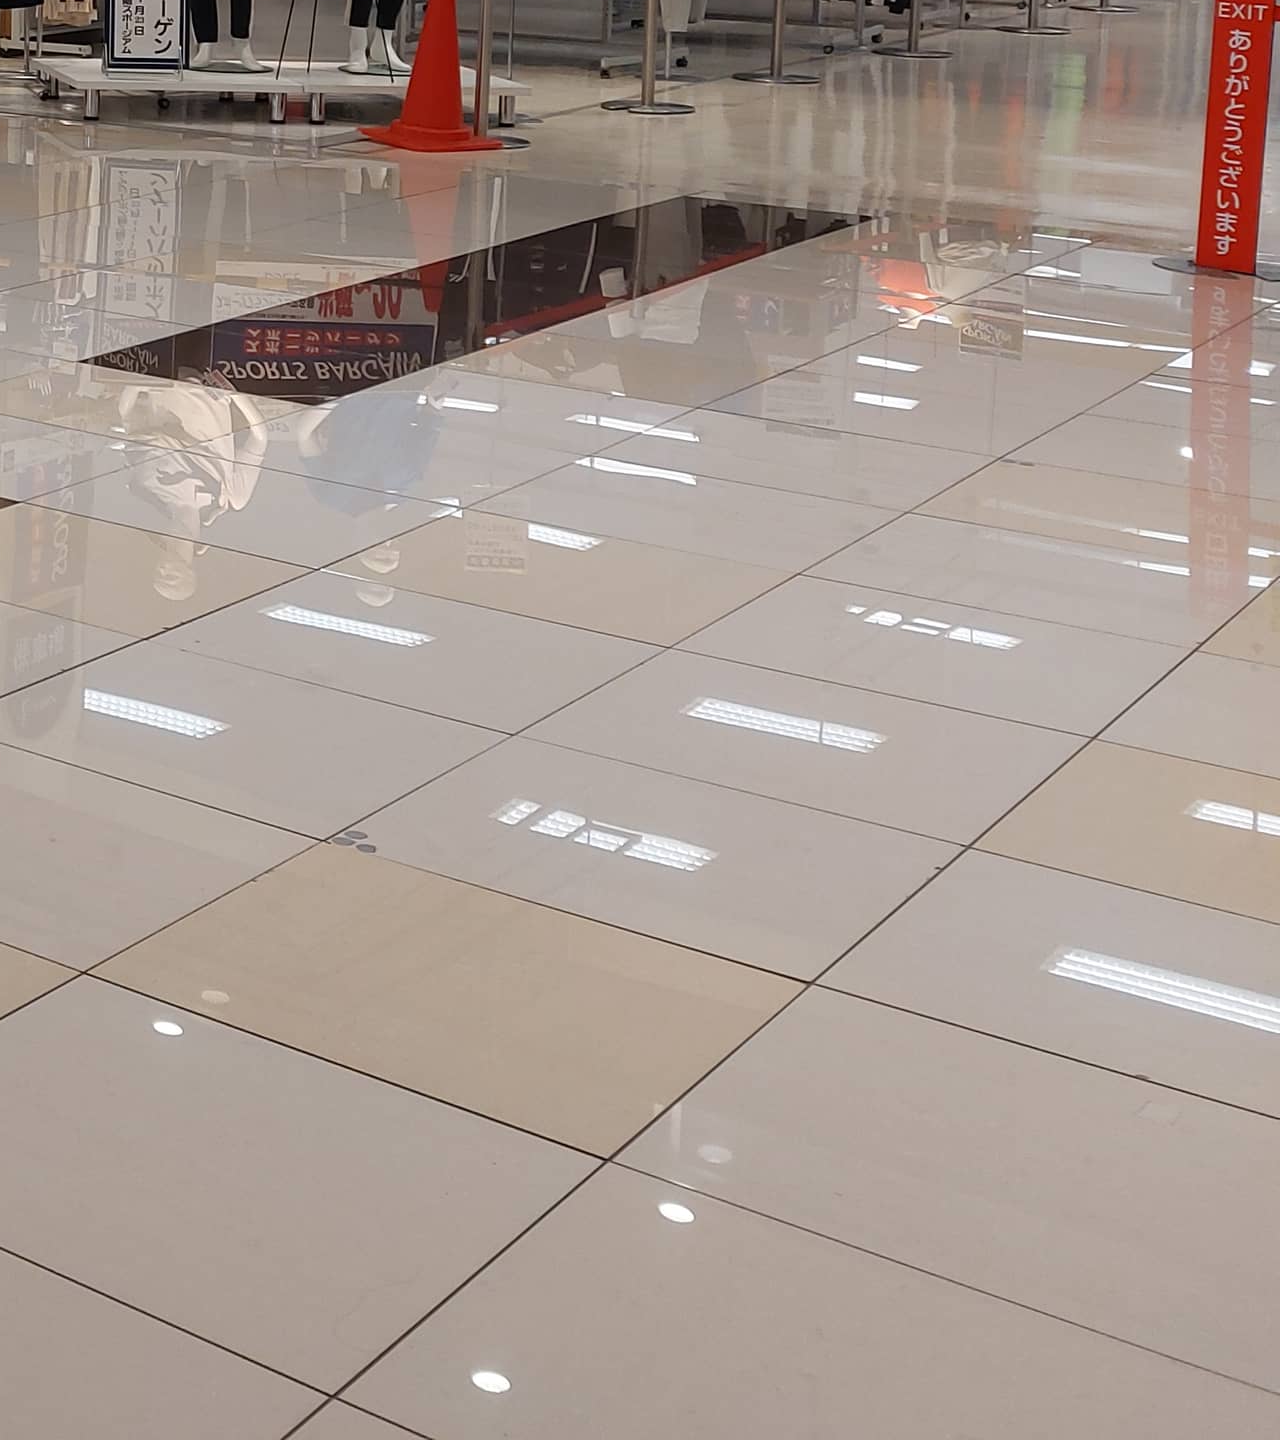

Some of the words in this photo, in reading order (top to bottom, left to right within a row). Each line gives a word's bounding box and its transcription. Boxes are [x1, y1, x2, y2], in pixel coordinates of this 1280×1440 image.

[1218, 2, 1269, 21] EXIT
[1215, 29, 1252, 257] ありがとうございます
